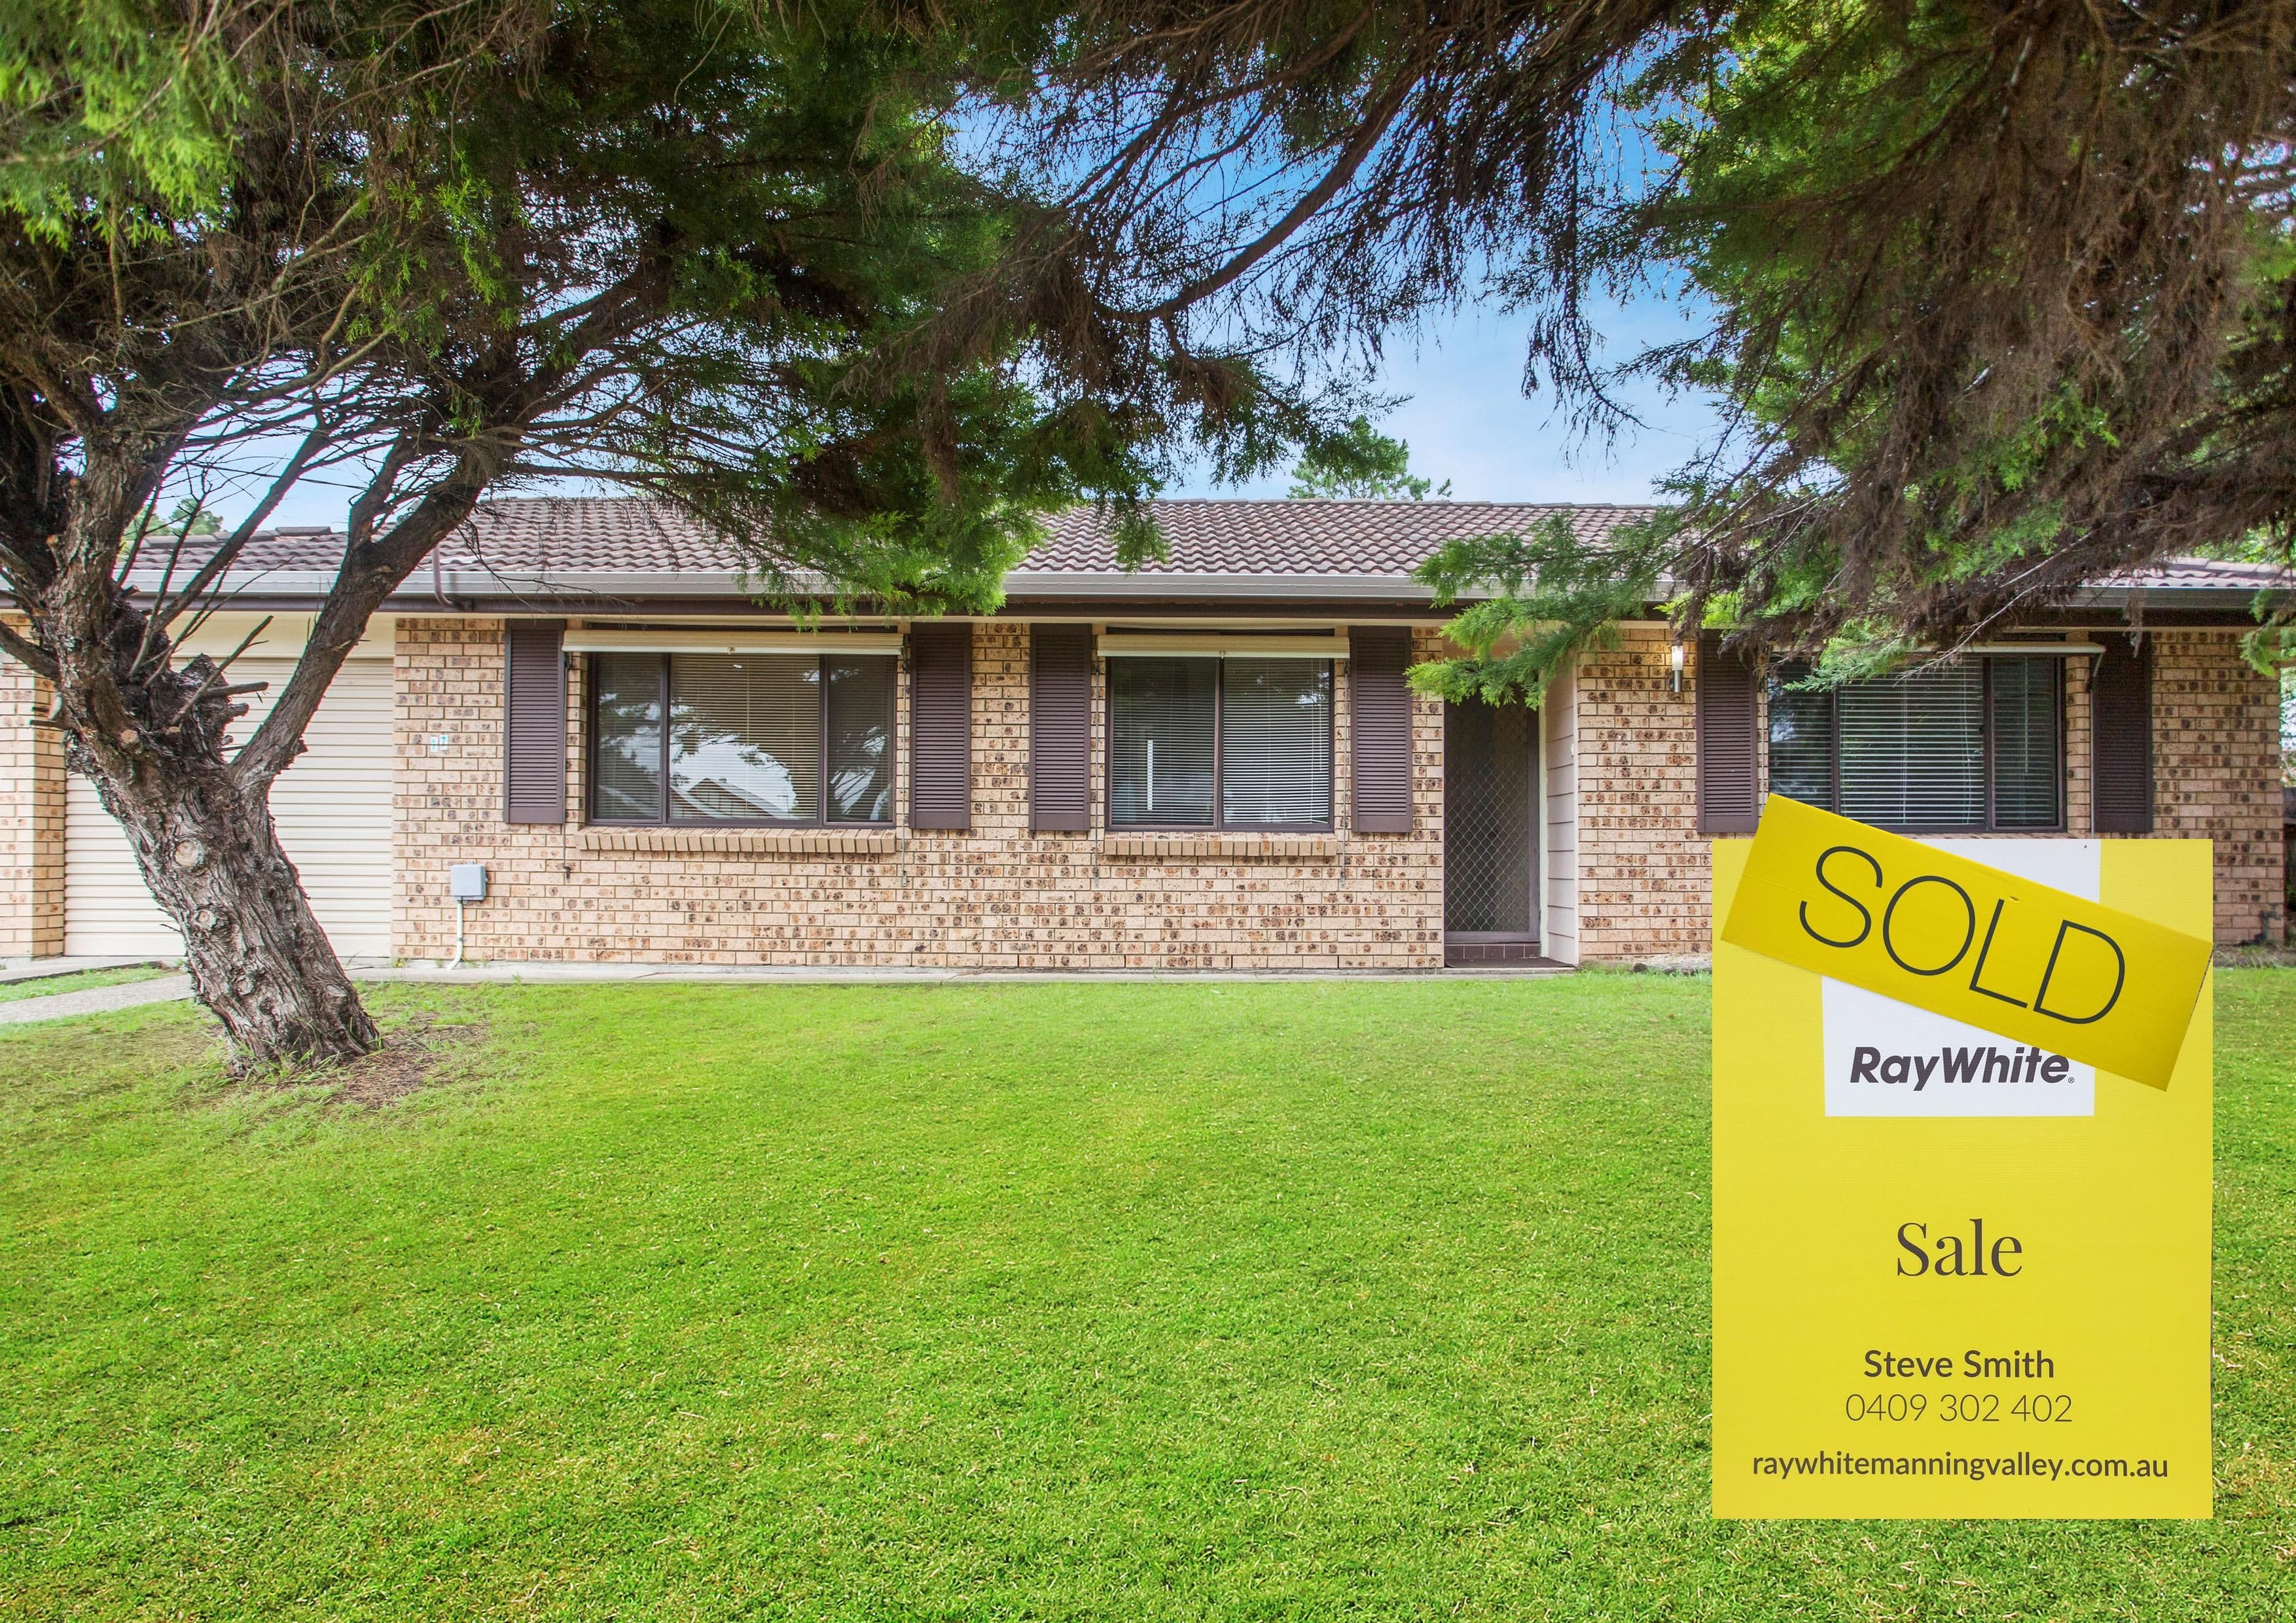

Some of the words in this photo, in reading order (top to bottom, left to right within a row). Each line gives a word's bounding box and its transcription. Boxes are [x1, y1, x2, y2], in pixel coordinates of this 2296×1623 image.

[1799, 846, 2126, 1025] SOLD
[1897, 1218, 2022, 1277] Sale
[1864, 1349, 1953, 1378] Steve
[1963, 1349, 2054, 1378] Smith
[1846, 1394, 1927, 1421] 0409
[1939, 1394, 2000, 1421] 302
[2011, 1395, 2072, 1422] 402
[1753, 1450, 2168, 1481] raywhitemanningvalley.com.au
